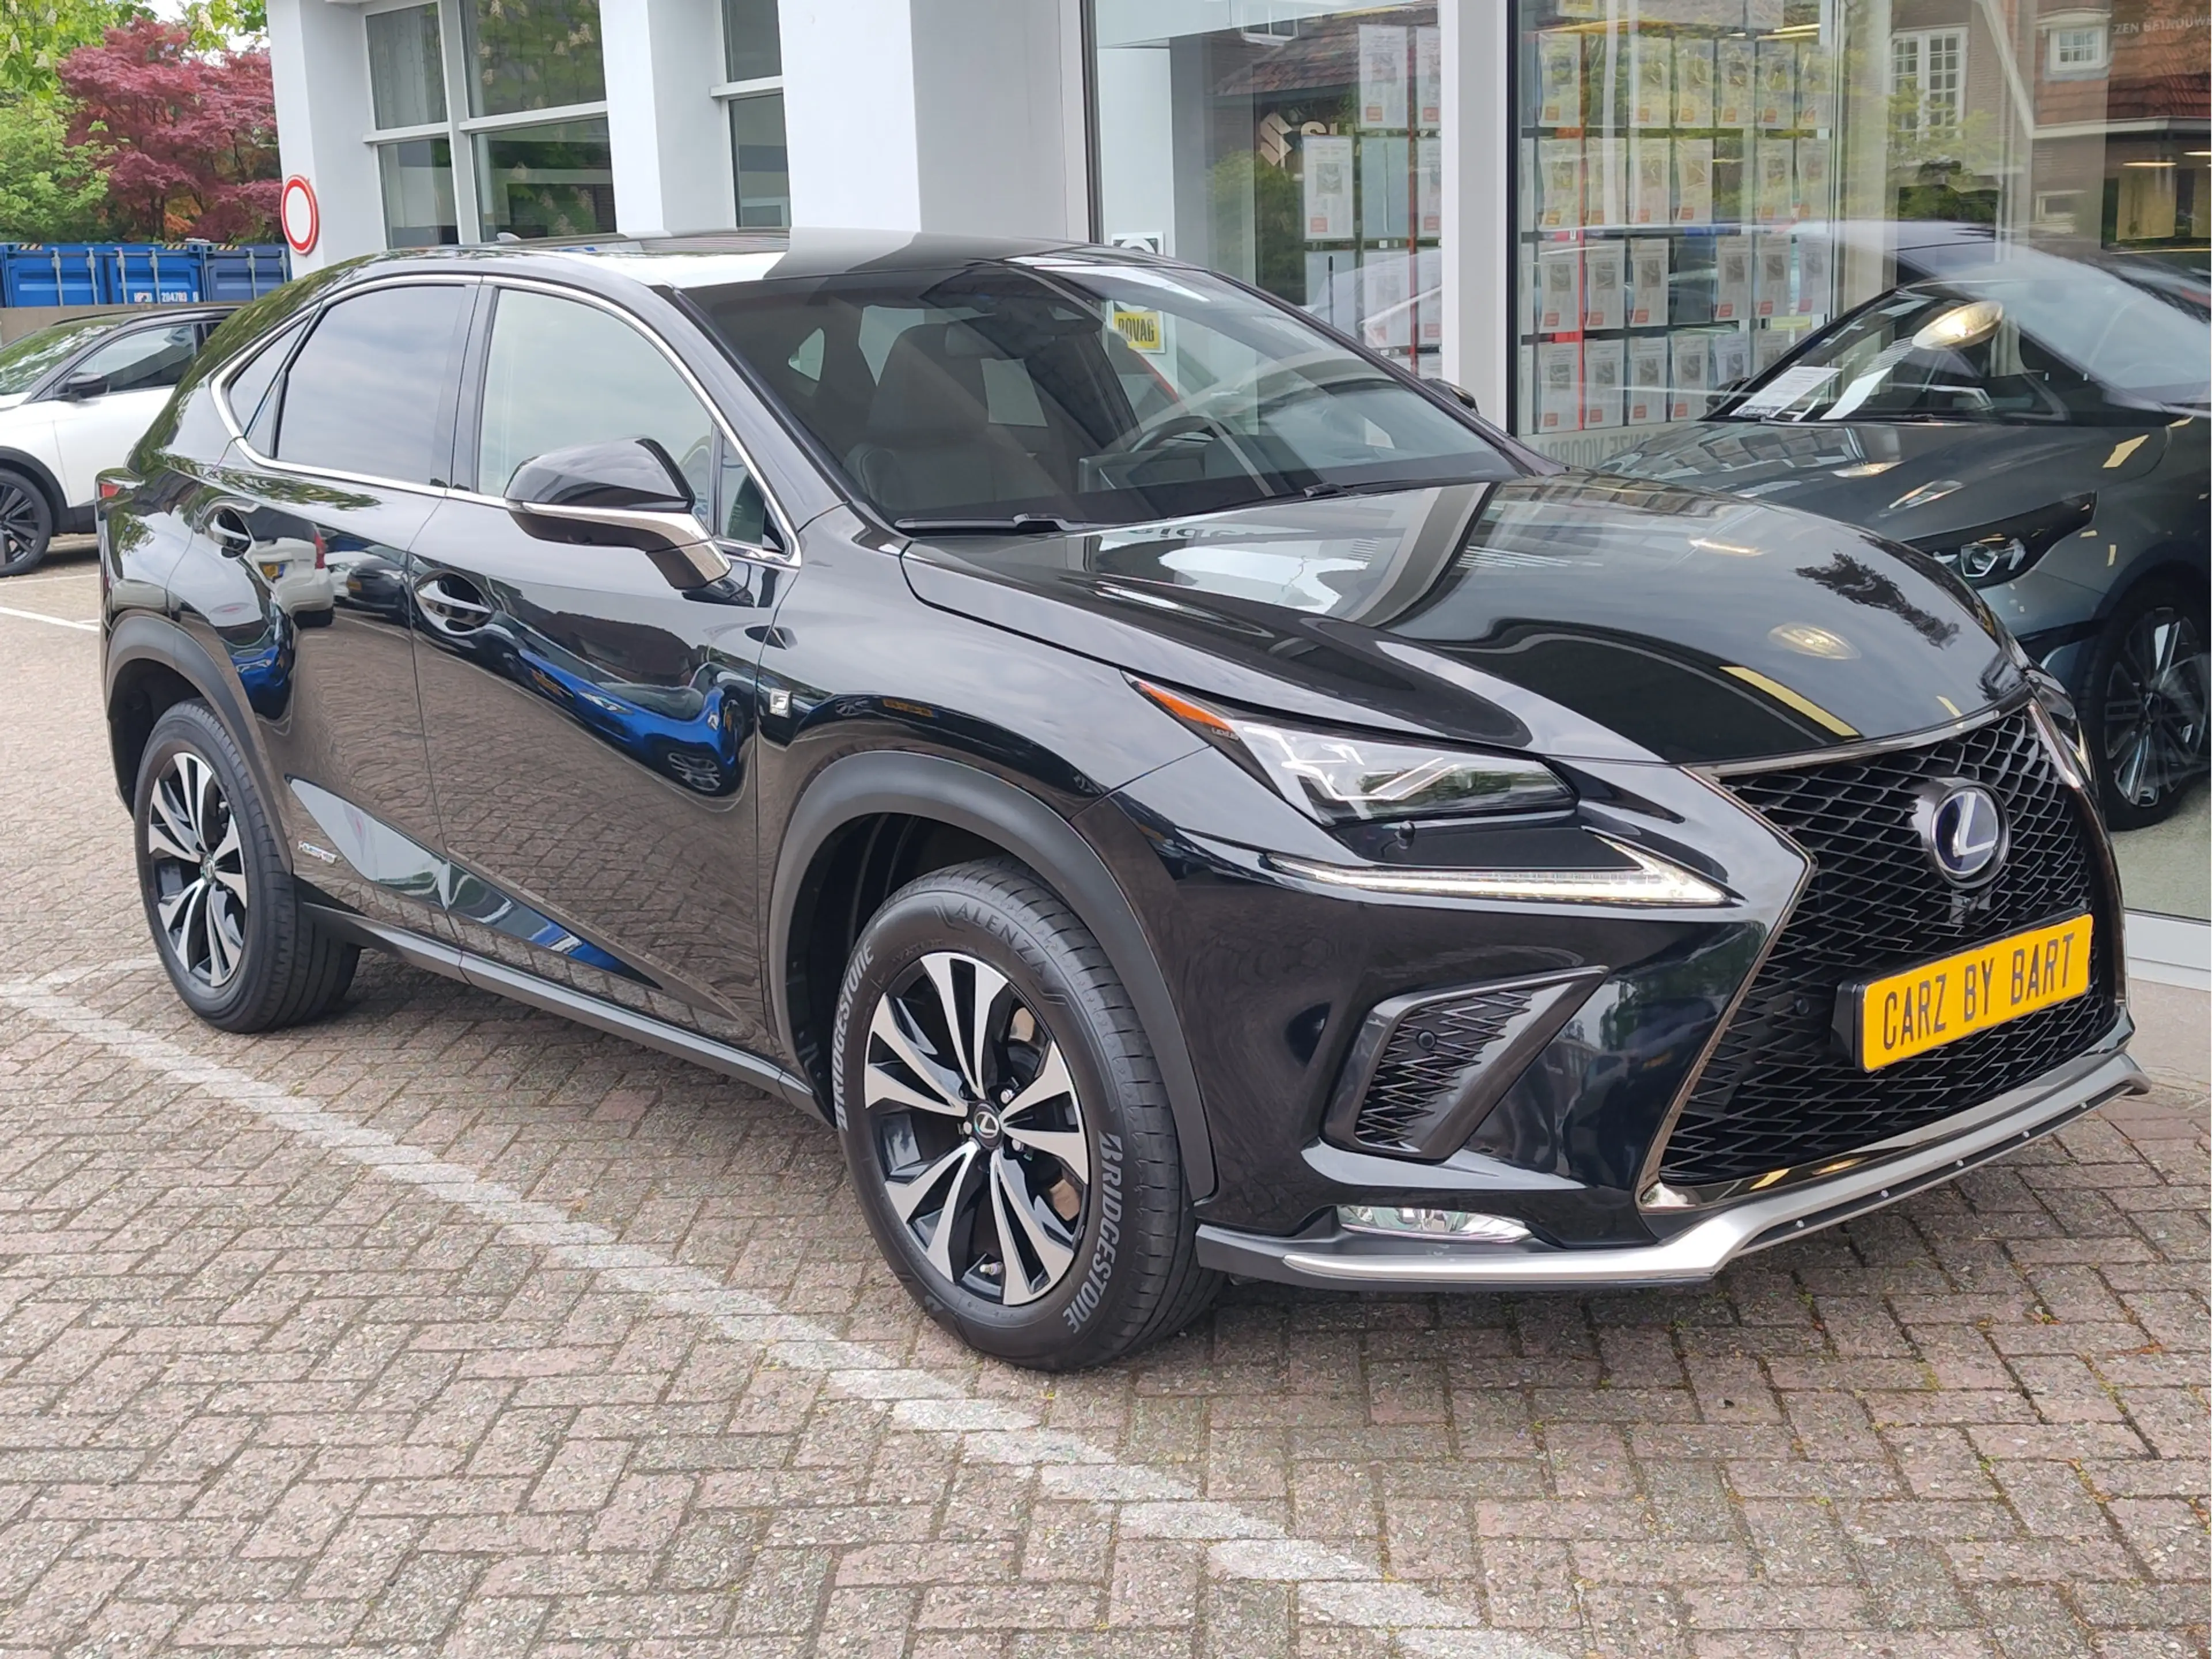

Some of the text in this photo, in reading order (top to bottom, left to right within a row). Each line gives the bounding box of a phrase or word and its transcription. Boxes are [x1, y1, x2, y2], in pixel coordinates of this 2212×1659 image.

[955, 902, 1047, 979] ALENZA
[1883, 932, 2075, 1050] CARZ BY BART
[832, 938, 874, 1131] BRIDGESTONE
[1063, 1130, 1123, 1333] BRIDGESTONE
